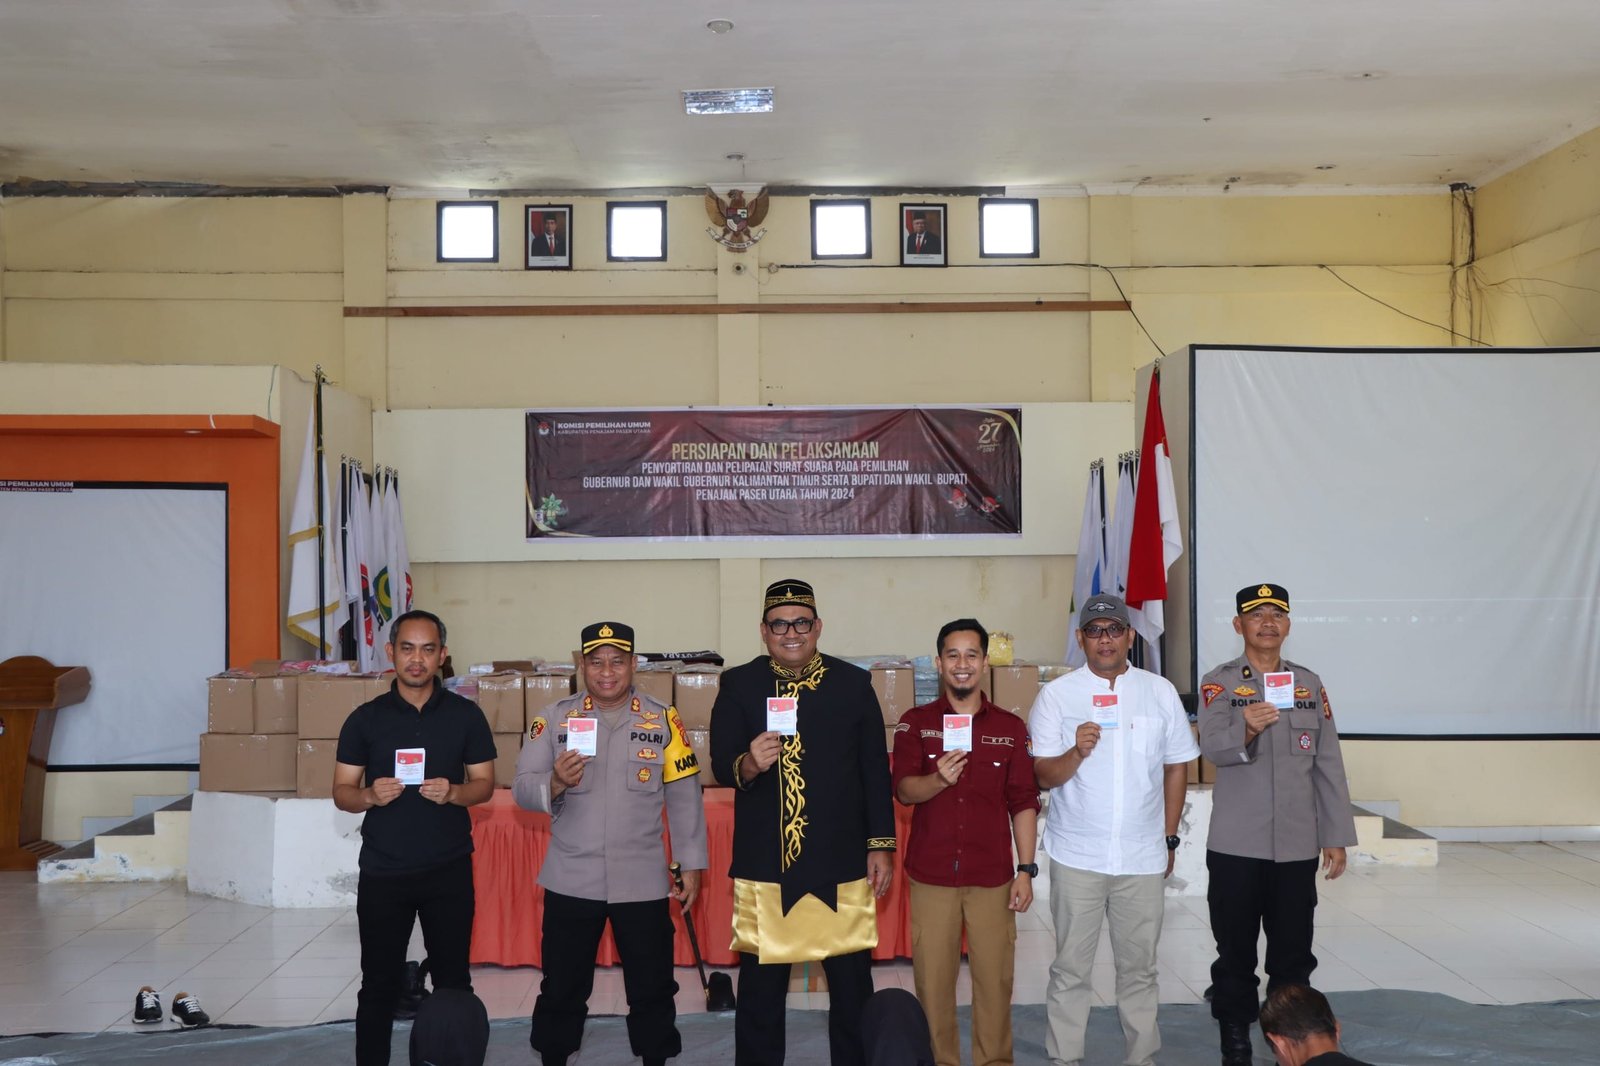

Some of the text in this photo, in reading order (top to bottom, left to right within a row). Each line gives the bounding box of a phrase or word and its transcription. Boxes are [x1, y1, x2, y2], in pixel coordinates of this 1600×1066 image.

[978, 423, 1002, 443] 27
[672, 441, 879, 460] PERSIAPAN DAN PELAKSANAAN
[641, 460, 909, 474] PENYORTIRAN DAN PELIPATAN SURAT SUARA PADA PEMILIHAN
[583, 473, 968, 488] GUBERNUR DAN WAKIL GUBERNUR KALIMANTAN TIMUR SERTA BUPATI DAN WAKIL BUPATI
[696, 488, 855, 501] PENAJAM PASER UTARA TAHUN 2024
[1294, 701, 1317, 710] OLRI
[630, 732, 664, 744] POLRI
